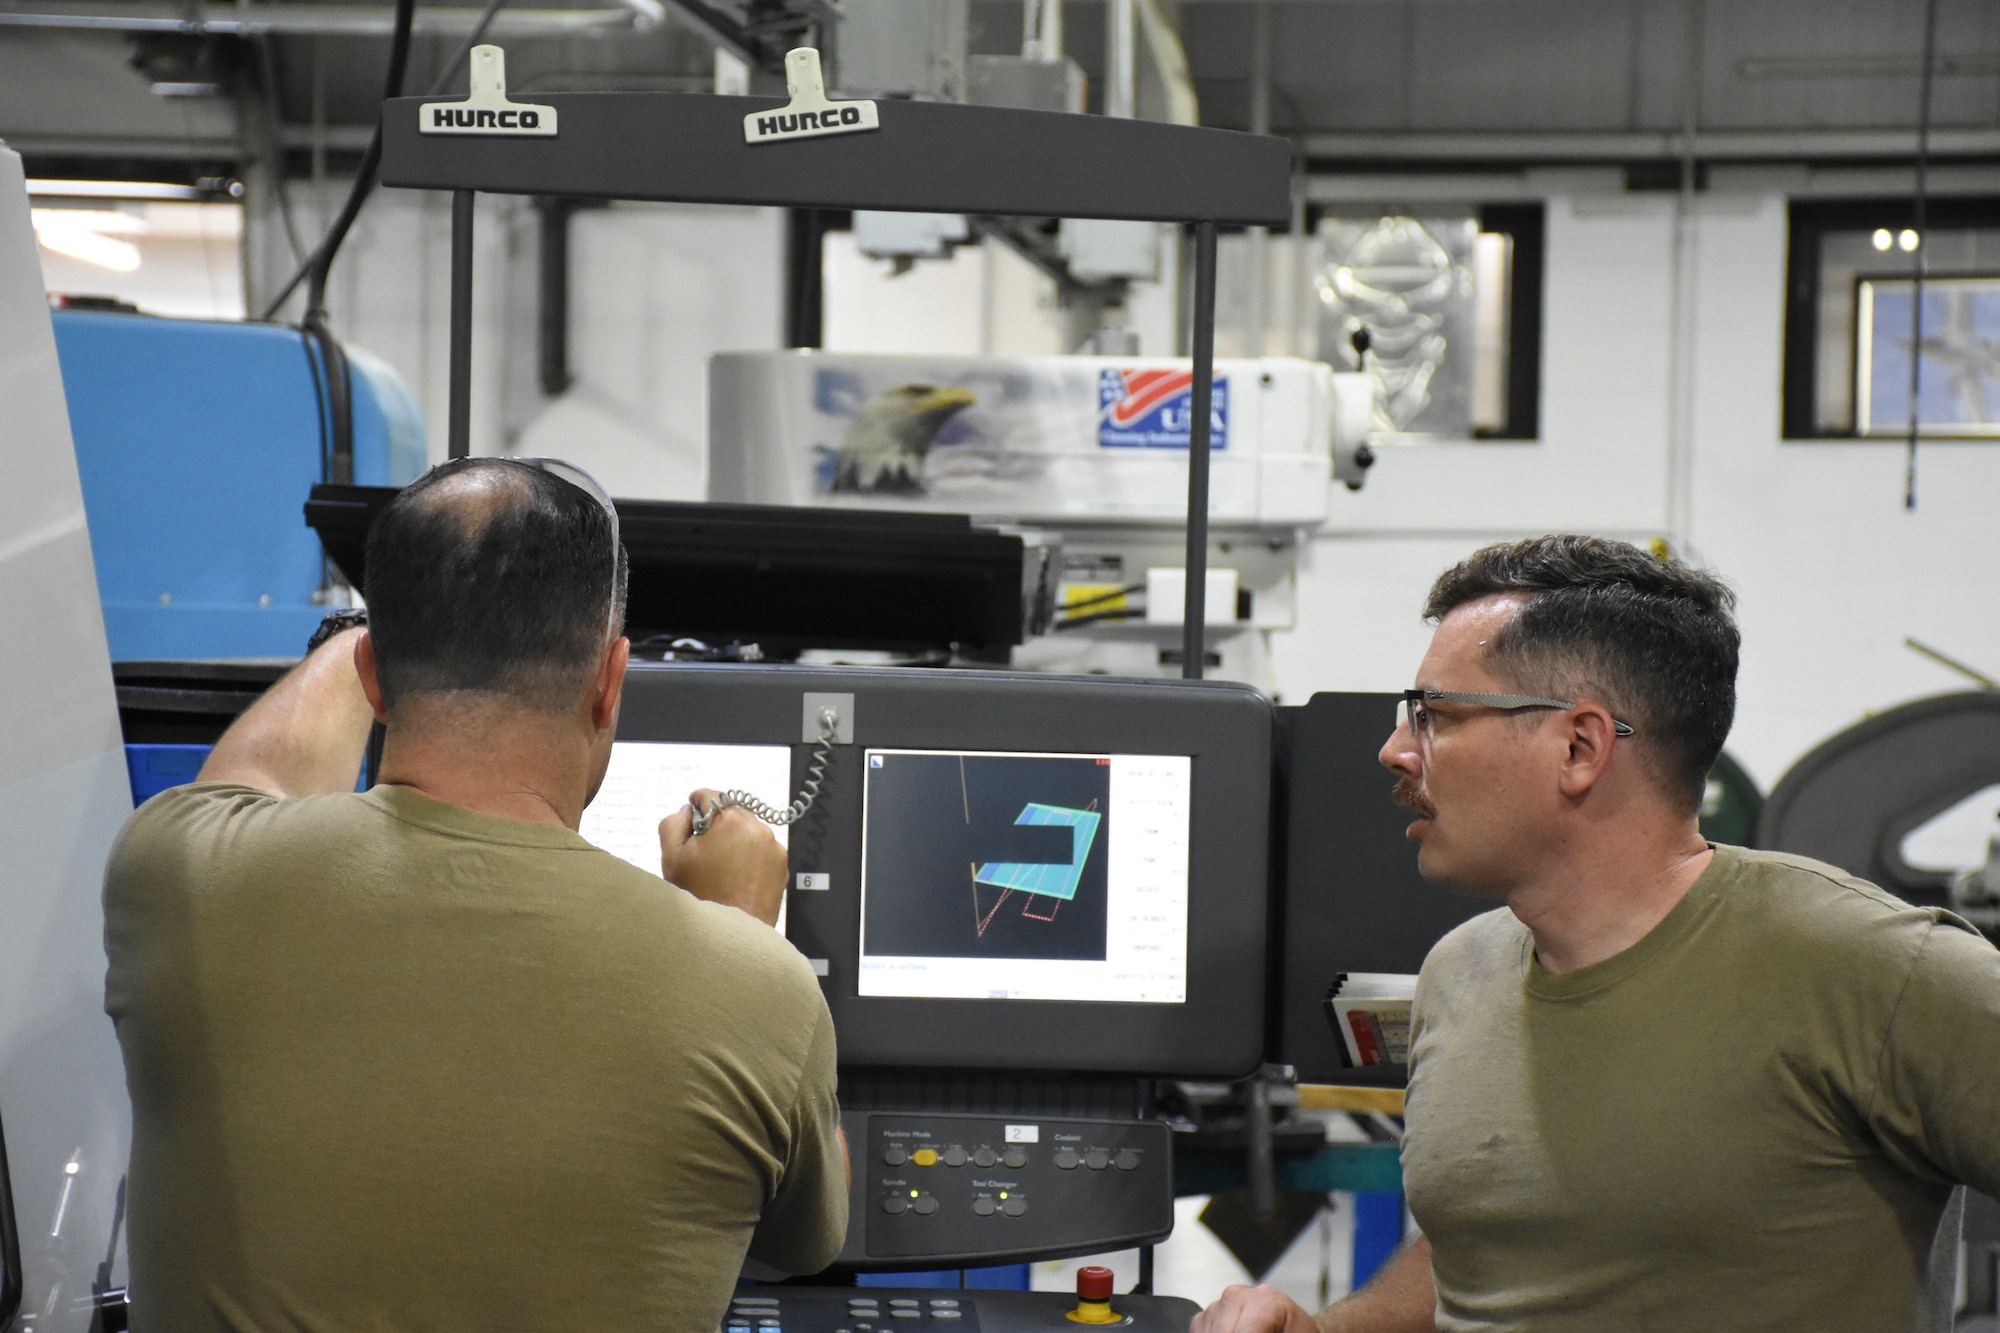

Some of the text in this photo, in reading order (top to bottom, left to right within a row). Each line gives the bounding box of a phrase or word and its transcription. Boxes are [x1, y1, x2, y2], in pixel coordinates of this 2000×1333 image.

[434, 109, 539, 129] HURCO
[757, 107, 860, 135] HURCO
[803, 875, 812, 888] 6
[1013, 1128, 1021, 1140] 2
